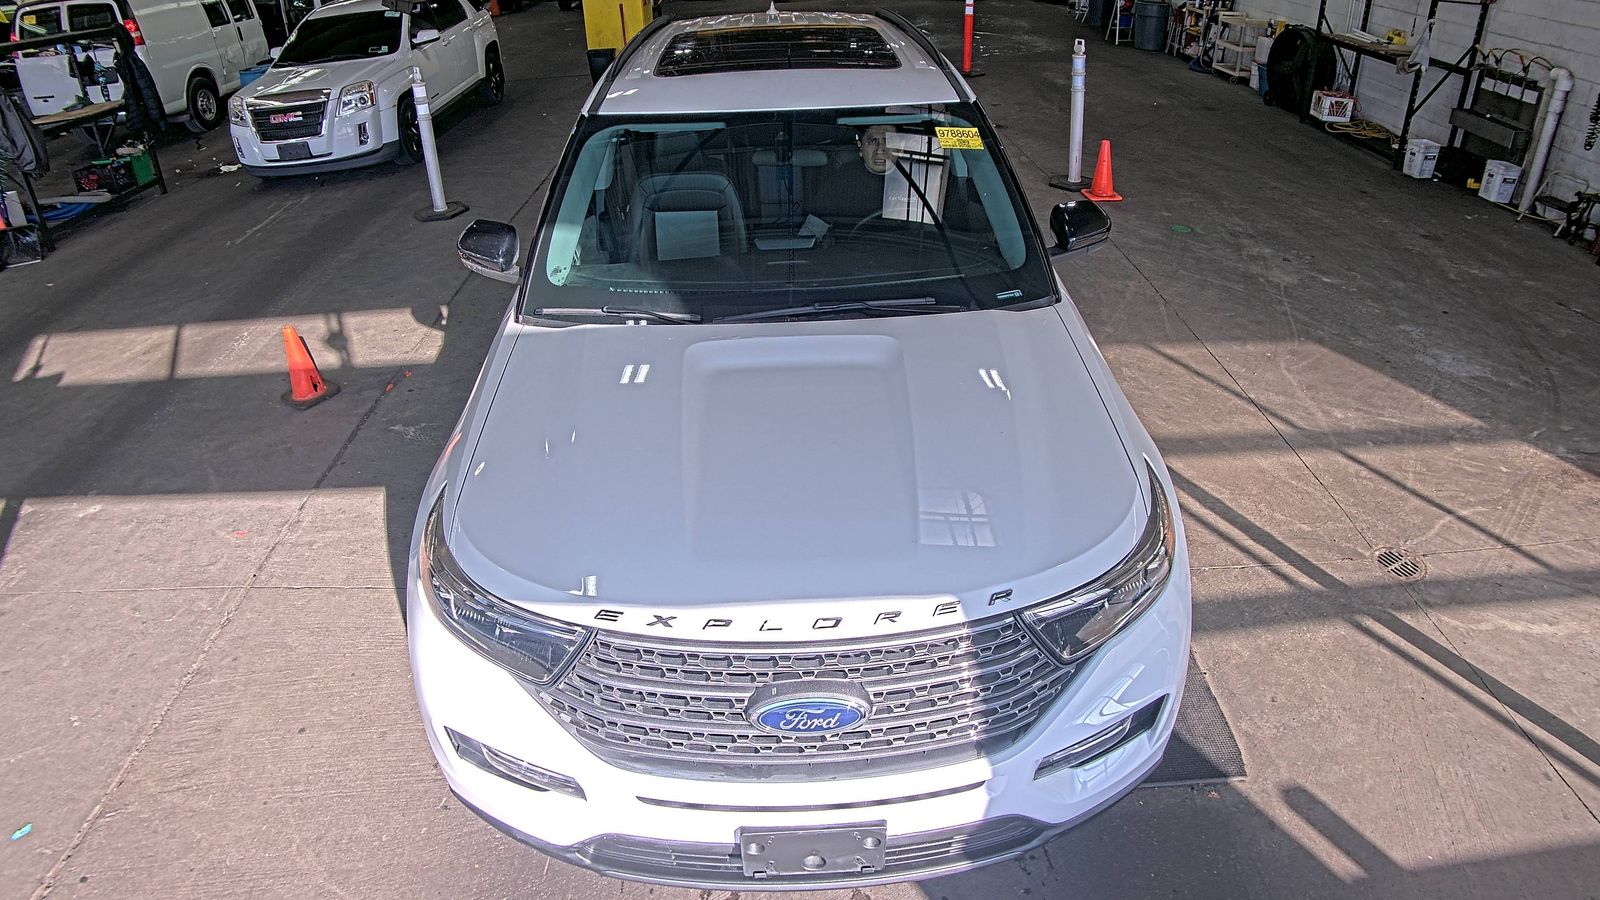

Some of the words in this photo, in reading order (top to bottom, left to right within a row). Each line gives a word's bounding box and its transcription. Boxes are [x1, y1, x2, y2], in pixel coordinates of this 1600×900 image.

[270, 111, 303, 124] GMC
[938, 129, 980, 139] 9788604
[594, 589, 1013, 632] EXPLORER
[780, 708, 841, 730] Ford
